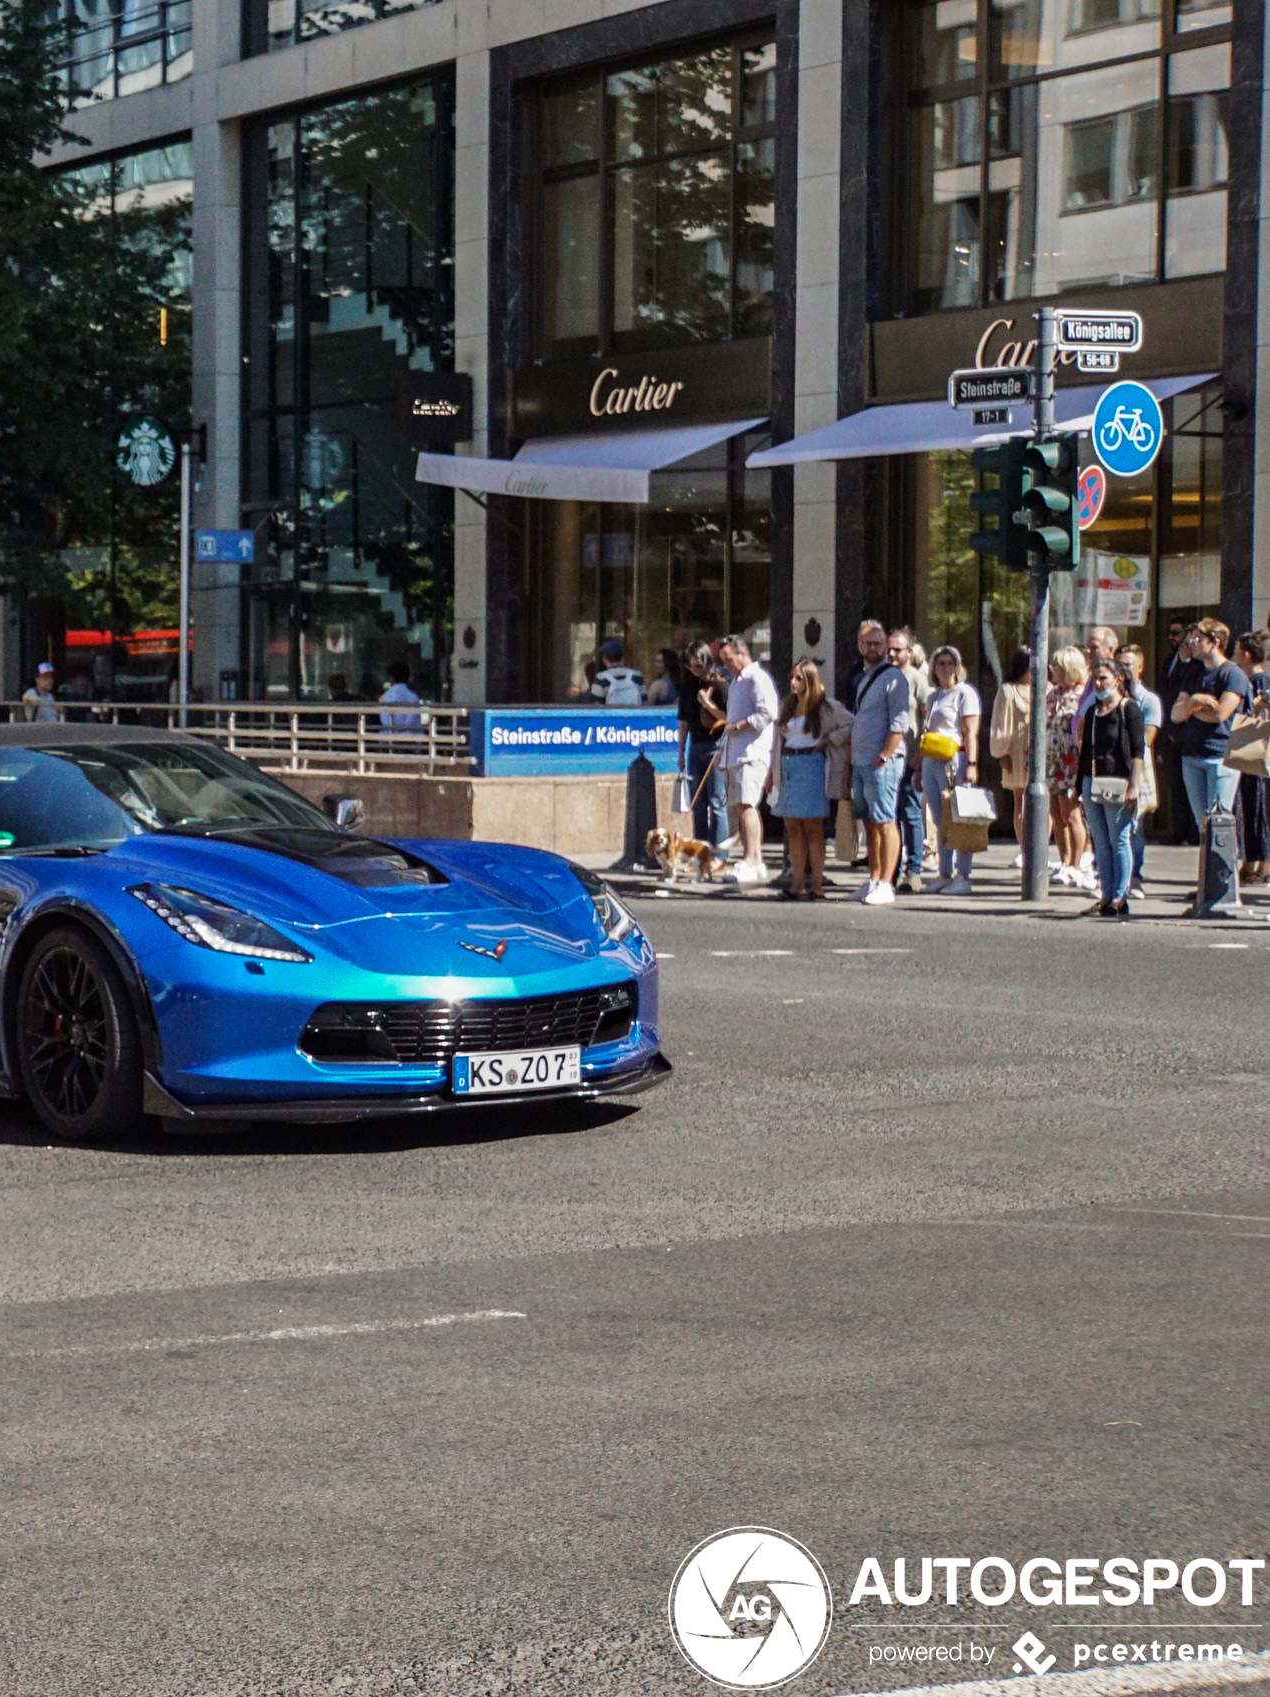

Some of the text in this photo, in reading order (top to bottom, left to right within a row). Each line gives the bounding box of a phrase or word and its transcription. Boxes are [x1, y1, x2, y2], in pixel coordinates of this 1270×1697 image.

[1067, 321, 1130, 342] Königsallee
[590, 369, 682, 417] Cartier
[960, 377, 1021, 398] Steinstraße
[491, 727, 581, 745] Steinstraße
[470, 1059, 503, 1087] KS
